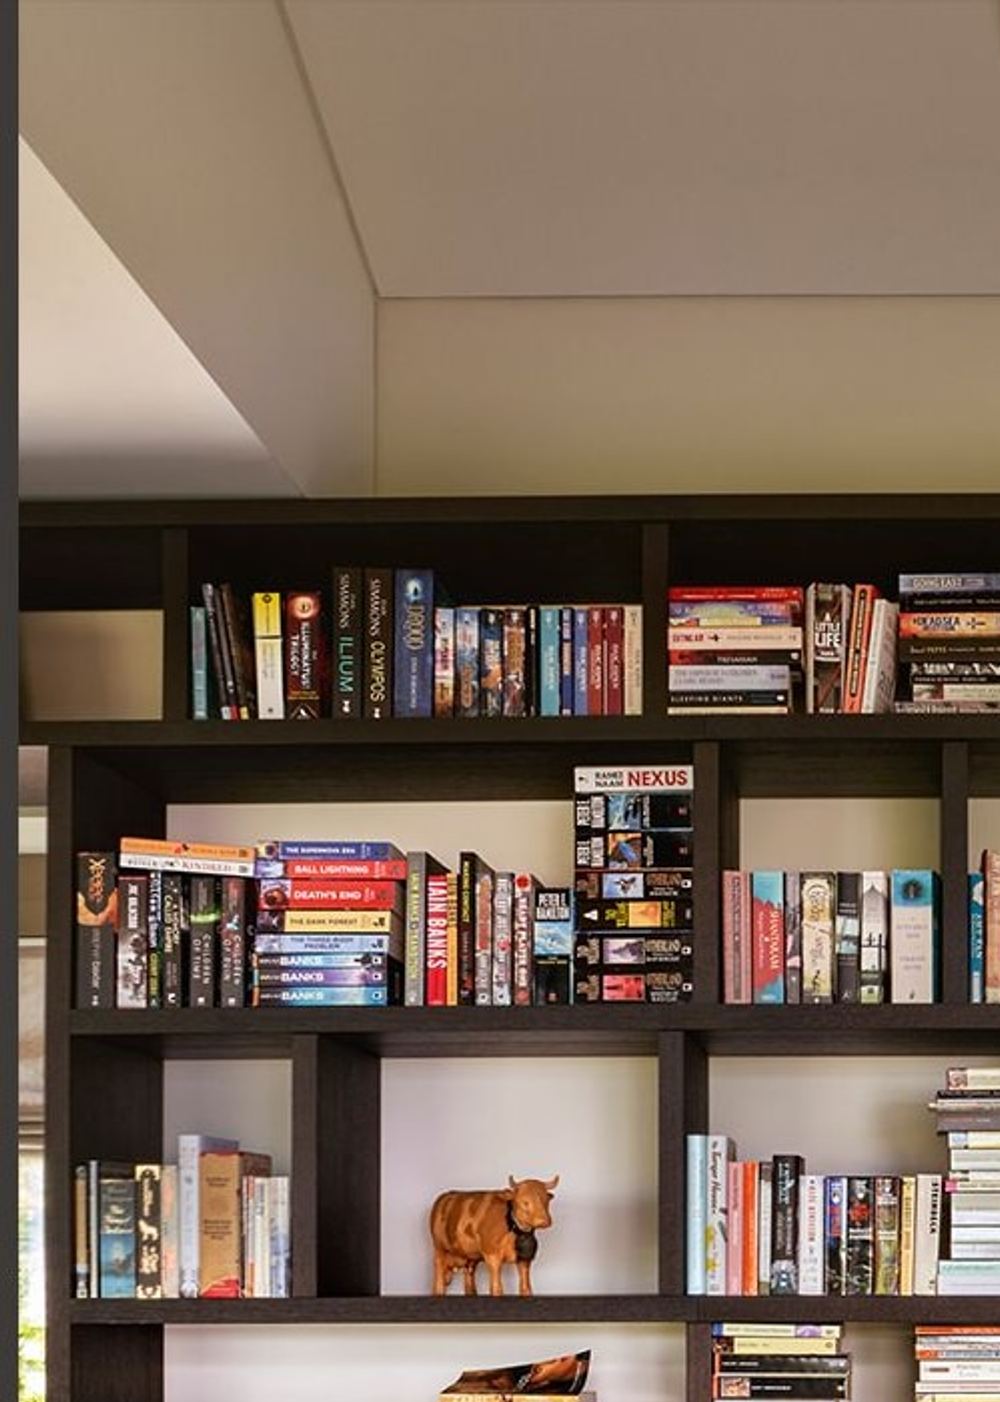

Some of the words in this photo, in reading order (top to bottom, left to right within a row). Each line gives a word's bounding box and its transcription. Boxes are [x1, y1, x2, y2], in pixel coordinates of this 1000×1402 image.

[815, 632, 841, 647] LIFE
[339, 637, 354, 693] ILIUM
[370, 641, 386, 702] OLYMPOS
[628, 771, 688, 786] NEXUS
[295, 865, 318, 874] BALL
[320, 865, 369, 874] LIGHTNING
[428, 881, 448, 911] IAIN
[193, 939, 201, 951] OF
[427, 918, 448, 969] BANKS
[770, 911, 779, 968] SHANTARAM
[193, 955, 201, 979] TIME
[202, 933, 211, 985] CHILDREN
[233, 934, 242, 985] CHILDREN
[281, 955, 323, 966] BANKS
[281, 972, 324, 982] BANKS
[281, 990, 324, 1000] BANKS
[930, 1182, 939, 1233] STEINBECK
